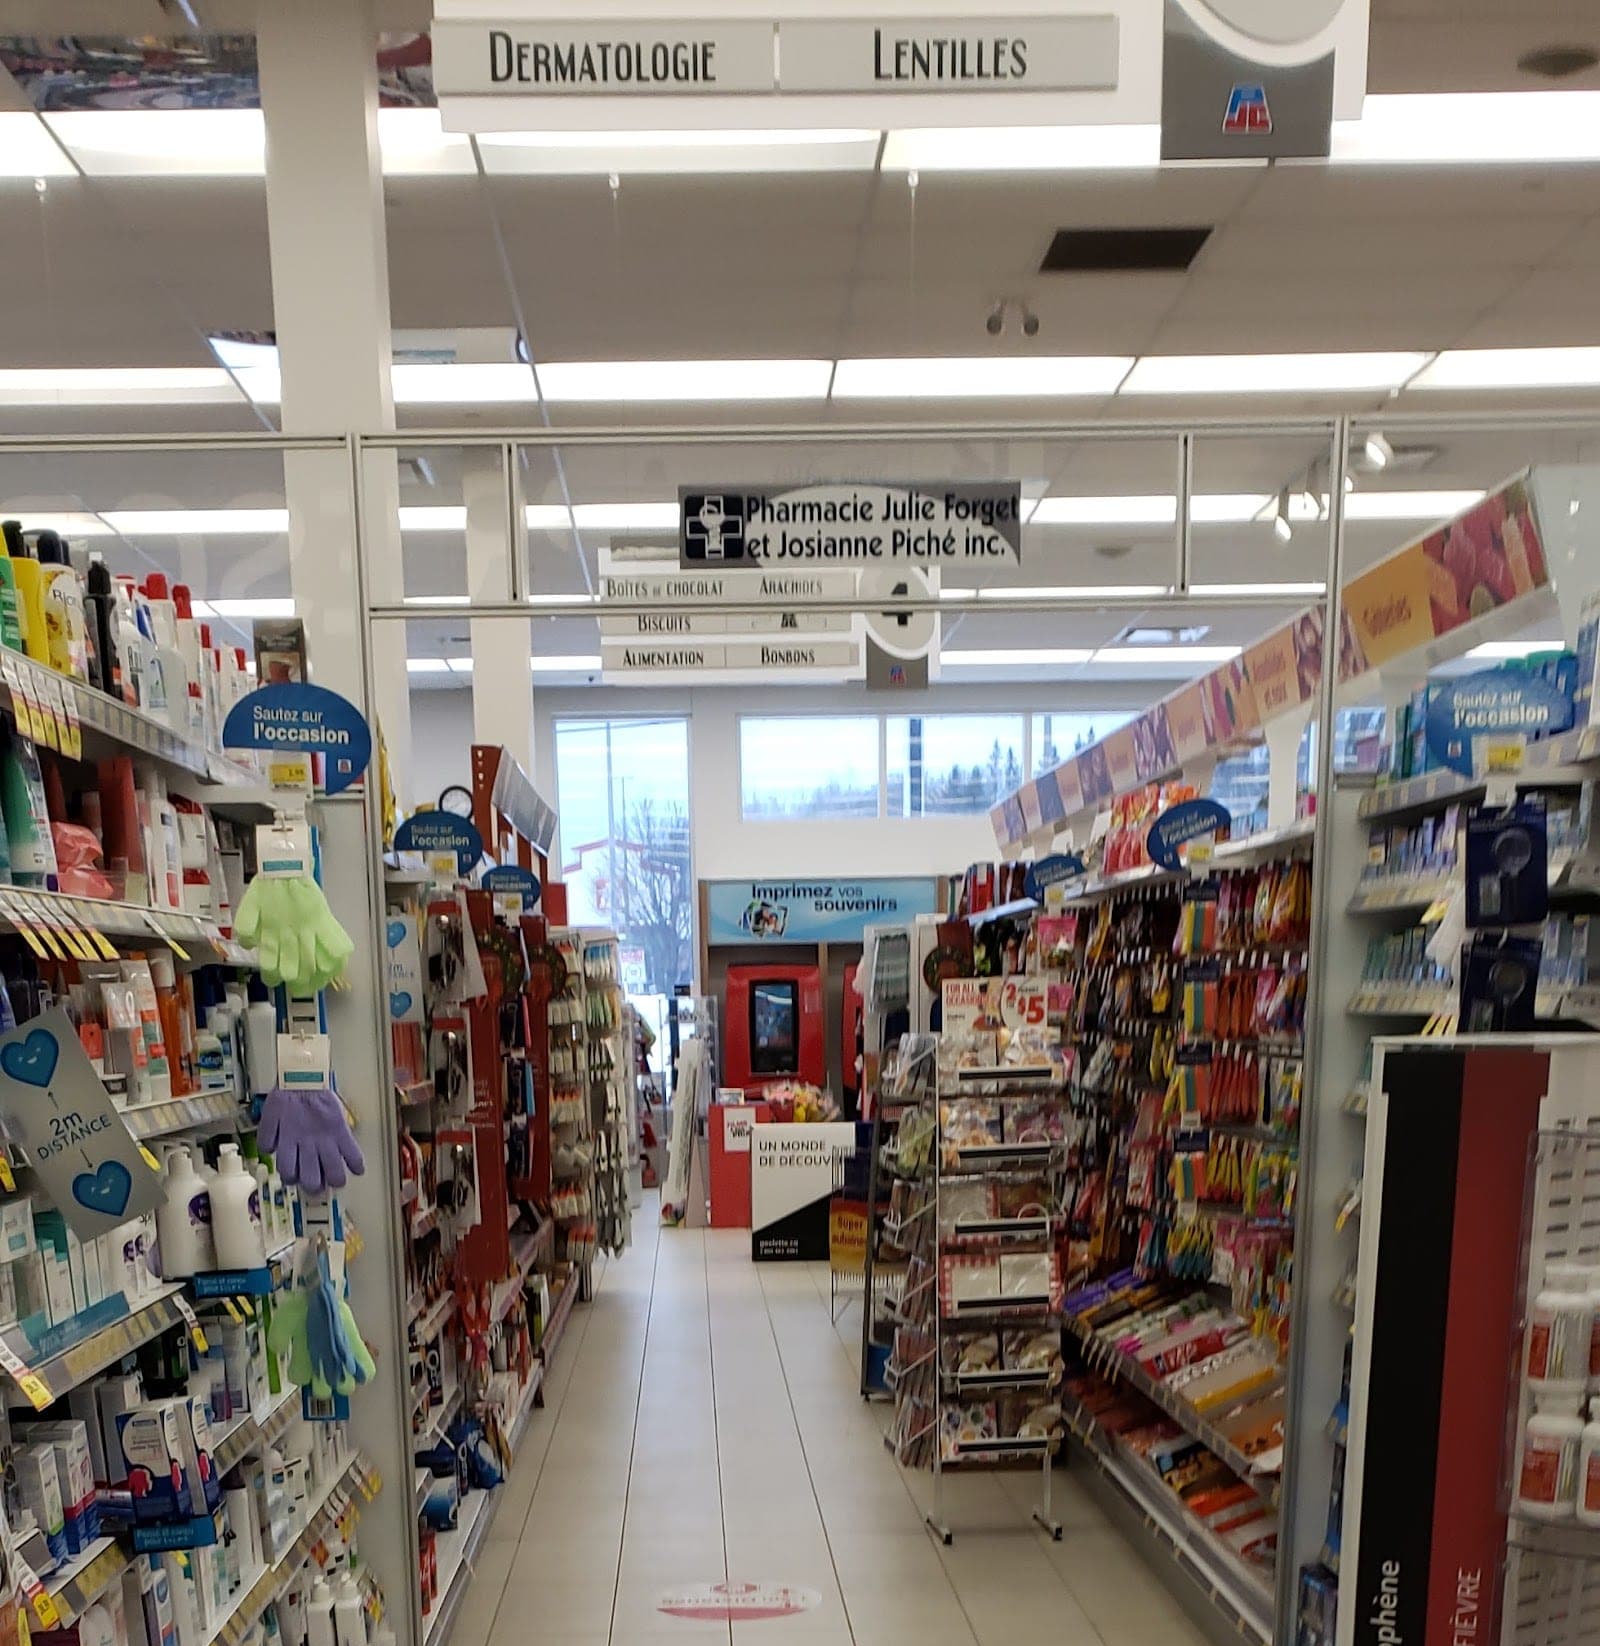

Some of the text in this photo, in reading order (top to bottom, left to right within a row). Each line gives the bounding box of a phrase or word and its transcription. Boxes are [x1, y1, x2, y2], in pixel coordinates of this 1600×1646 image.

[489, 29, 717, 83] DERMATOLOGIE
[873, 28, 1028, 82] LENTILLES
[748, 493, 1020, 526] Pharmacie Julie Forget
[749, 528, 1006, 558] et Josianne Piché inc.
[881, 582, 914, 626] 4
[637, 614, 692, 633] BISCUITS
[622, 648, 705, 668] ALIMENTATION
[760, 646, 816, 665] BONBONS
[253, 705, 323, 723] Sautez sur
[1454, 704, 1549, 730] l'occasion
[253, 722, 350, 745] l'occasion
[411, 834, 470, 847] l'occasion
[752, 882, 863, 901] Imprimez vos
[814, 896, 898, 911] souvenirs
[1006, 983, 1017, 1001] 2
[1017, 995, 1045, 1025] $5
[49, 1112, 83, 1136] 2m
[37, 1114, 112, 1160] DISTANCE
[759, 1140, 826, 1151] UN MONDE
[759, 1155, 775, 1166] DE
